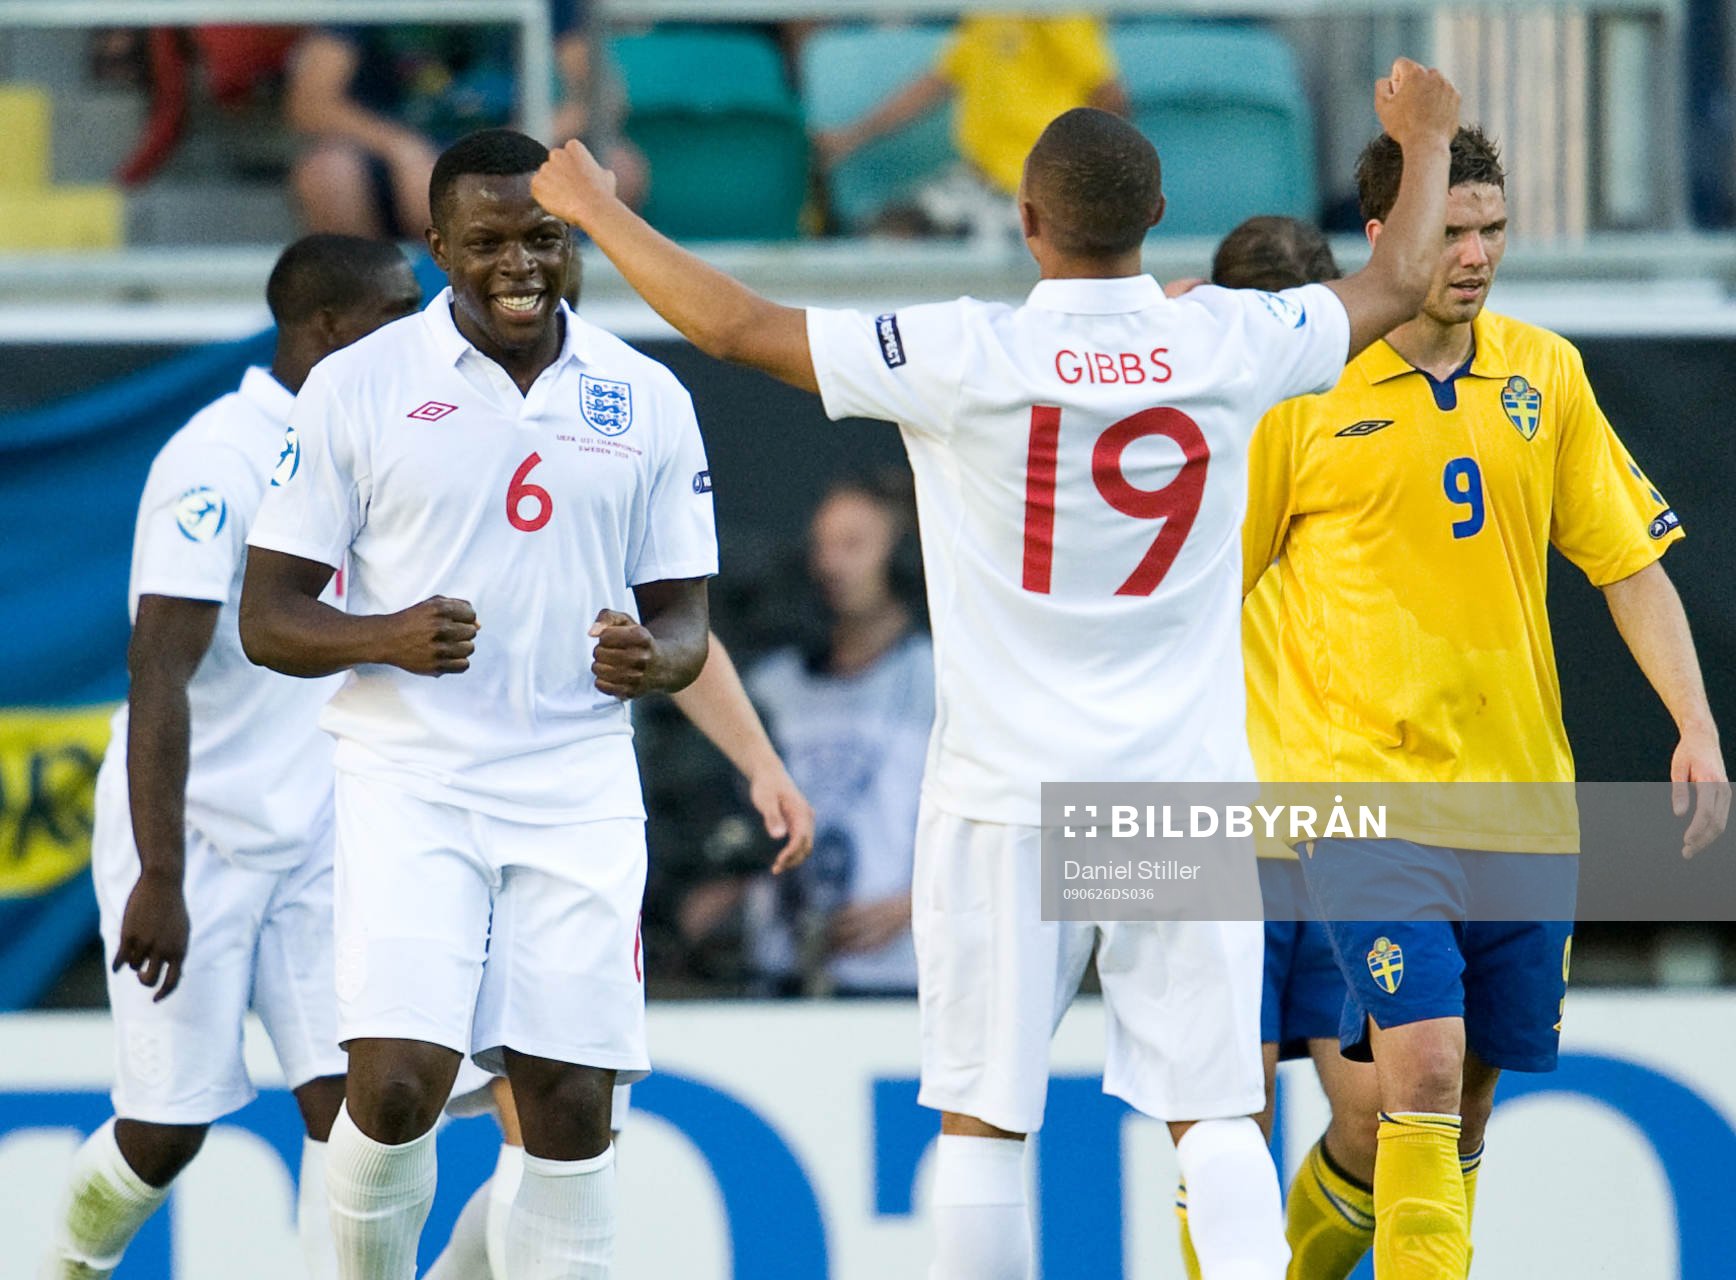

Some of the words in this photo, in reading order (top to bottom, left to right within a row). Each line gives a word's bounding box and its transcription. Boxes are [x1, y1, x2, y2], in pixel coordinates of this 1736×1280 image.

[1055, 348, 1172, 384] GIBBS
[506, 451, 553, 532] 6
[1022, 405, 1211, 597] 19
[1443, 457, 1486, 540] 9
